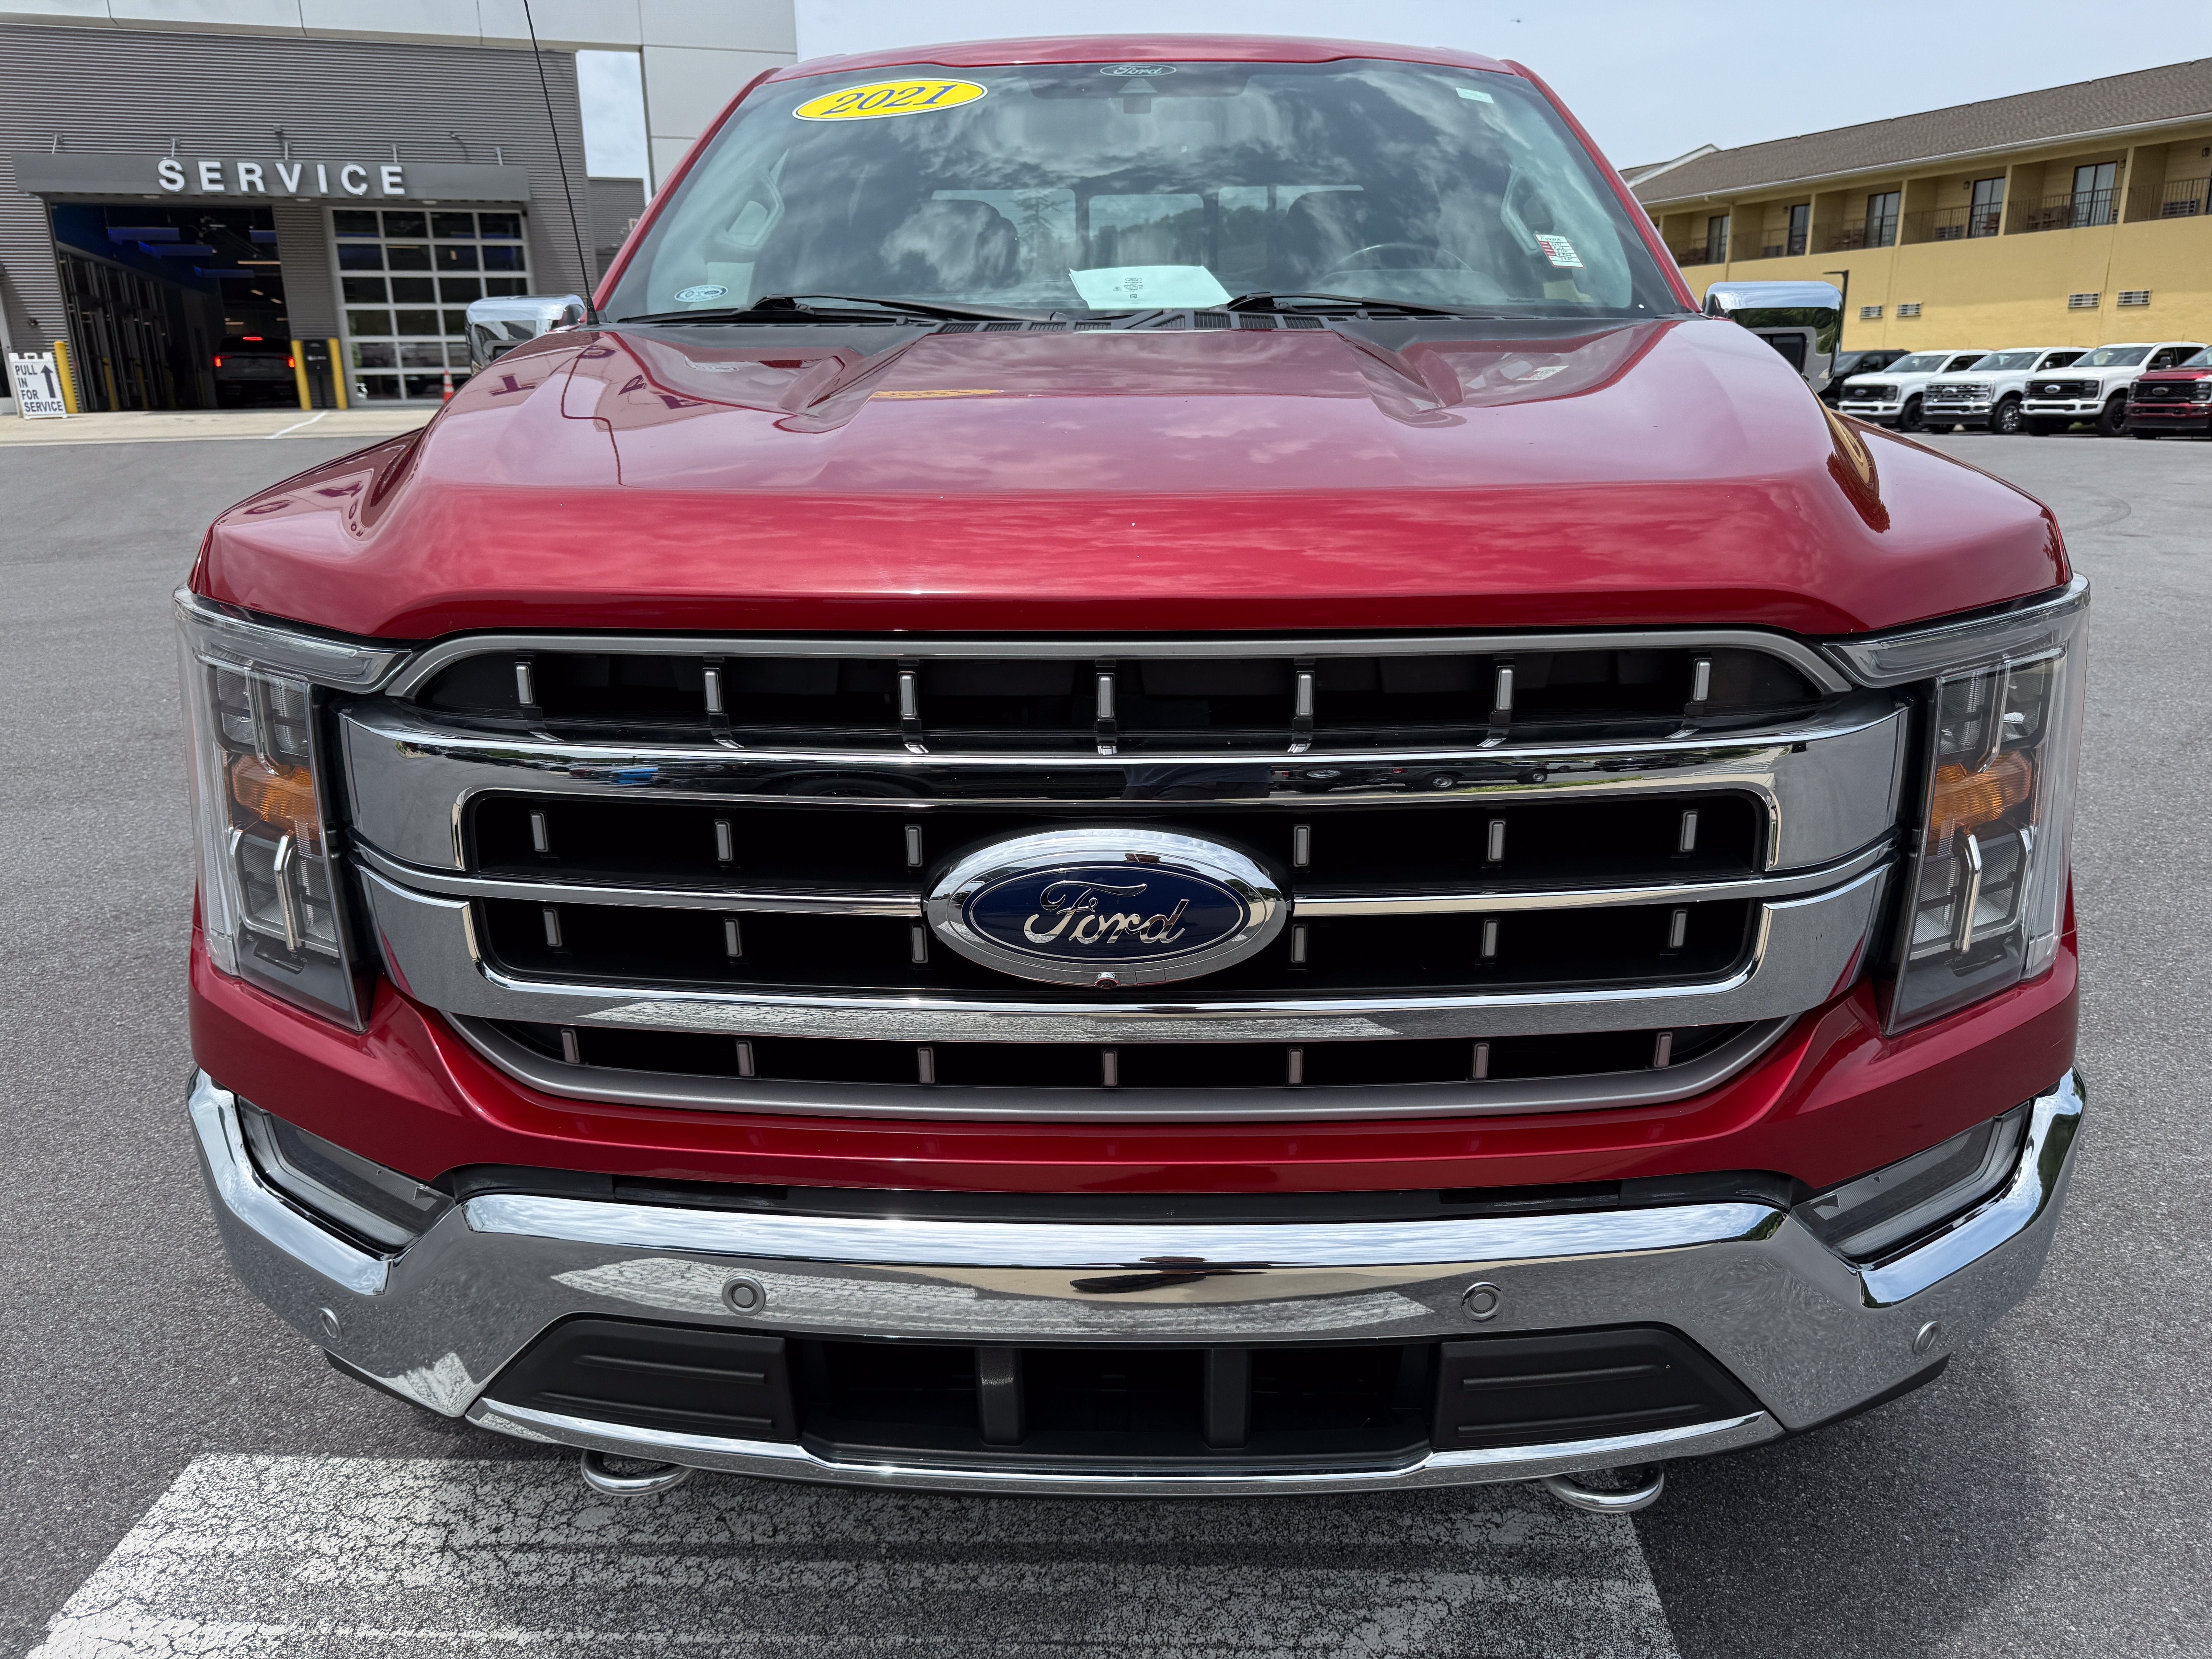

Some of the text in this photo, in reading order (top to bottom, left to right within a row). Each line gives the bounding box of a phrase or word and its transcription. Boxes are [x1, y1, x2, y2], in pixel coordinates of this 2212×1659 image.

[1113, 65, 1163, 74] Ford
[820, 84, 958, 115] 2021
[157, 157, 406, 196] SERVICE
[15, 364, 38, 376] PULL
[17, 377, 28, 388] IN
[21, 390, 40, 400] FOR
[24, 401, 63, 412] SERVICE
[1024, 880, 1189, 944] Ford
